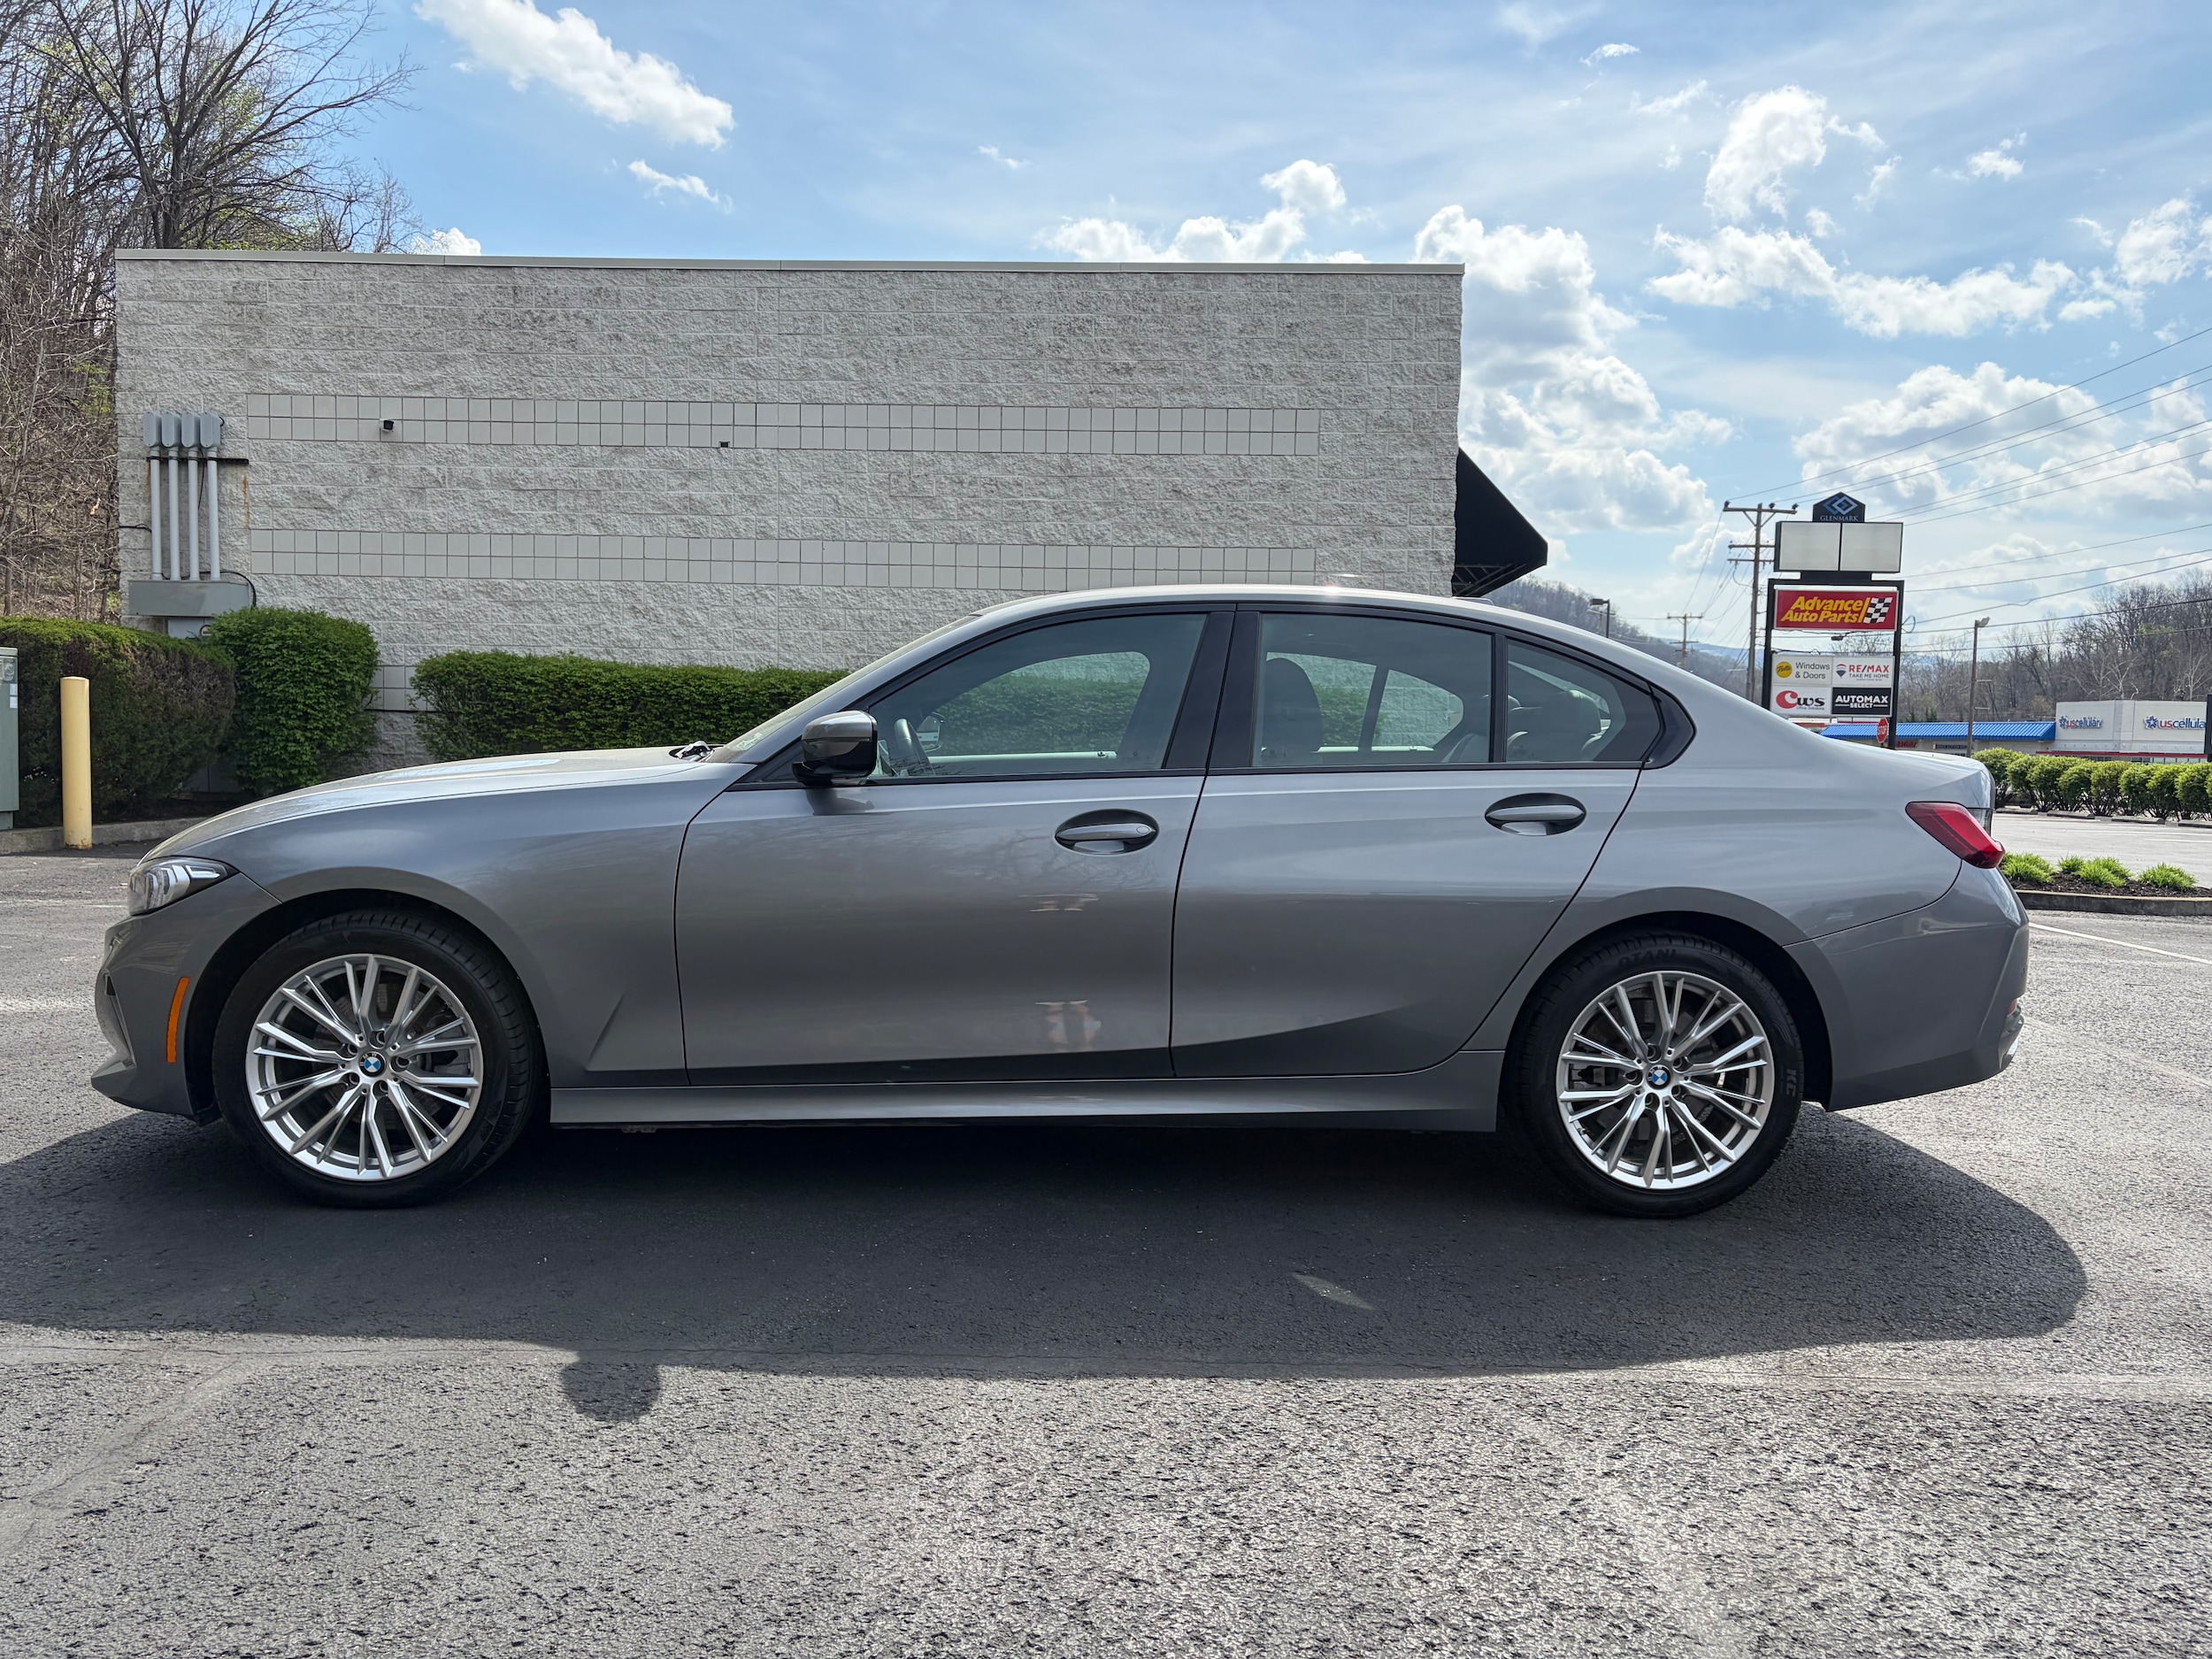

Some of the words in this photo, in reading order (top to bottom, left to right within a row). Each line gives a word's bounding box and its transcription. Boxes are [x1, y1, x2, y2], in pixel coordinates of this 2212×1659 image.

[1790, 595, 1863, 611] Advance
[1780, 610, 1818, 622] Auto
[1818, 611, 1860, 623] Parts
[1795, 662, 1831, 671] Windows
[1848, 664, 1890, 673] RE/MAX
[1834, 695, 1889, 703] AUTOMAX
[2160, 718, 2206, 729] uscellula
